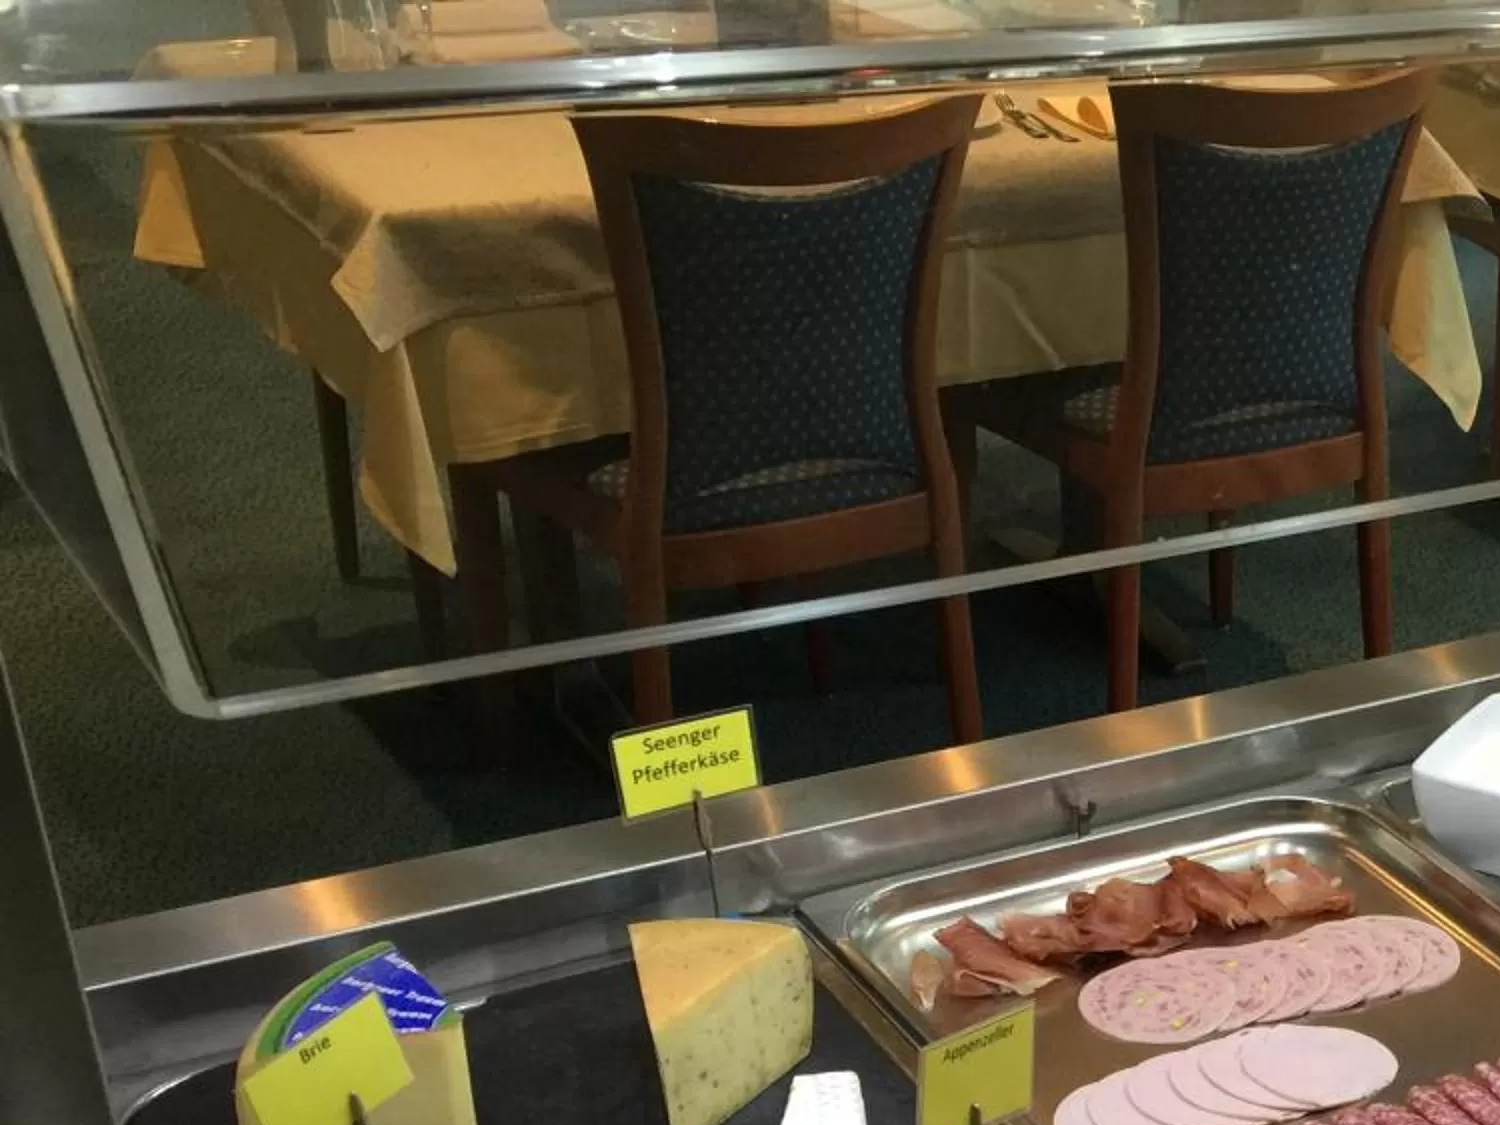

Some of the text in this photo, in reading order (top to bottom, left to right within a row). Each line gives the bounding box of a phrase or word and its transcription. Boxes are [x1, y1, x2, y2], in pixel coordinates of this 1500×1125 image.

[642, 724, 721, 755] Seenger
[632, 748, 741, 785] Pfefferkäse
[299, 1035, 333, 1066] Brie
[942, 1023, 1015, 1065] Appenzeller
